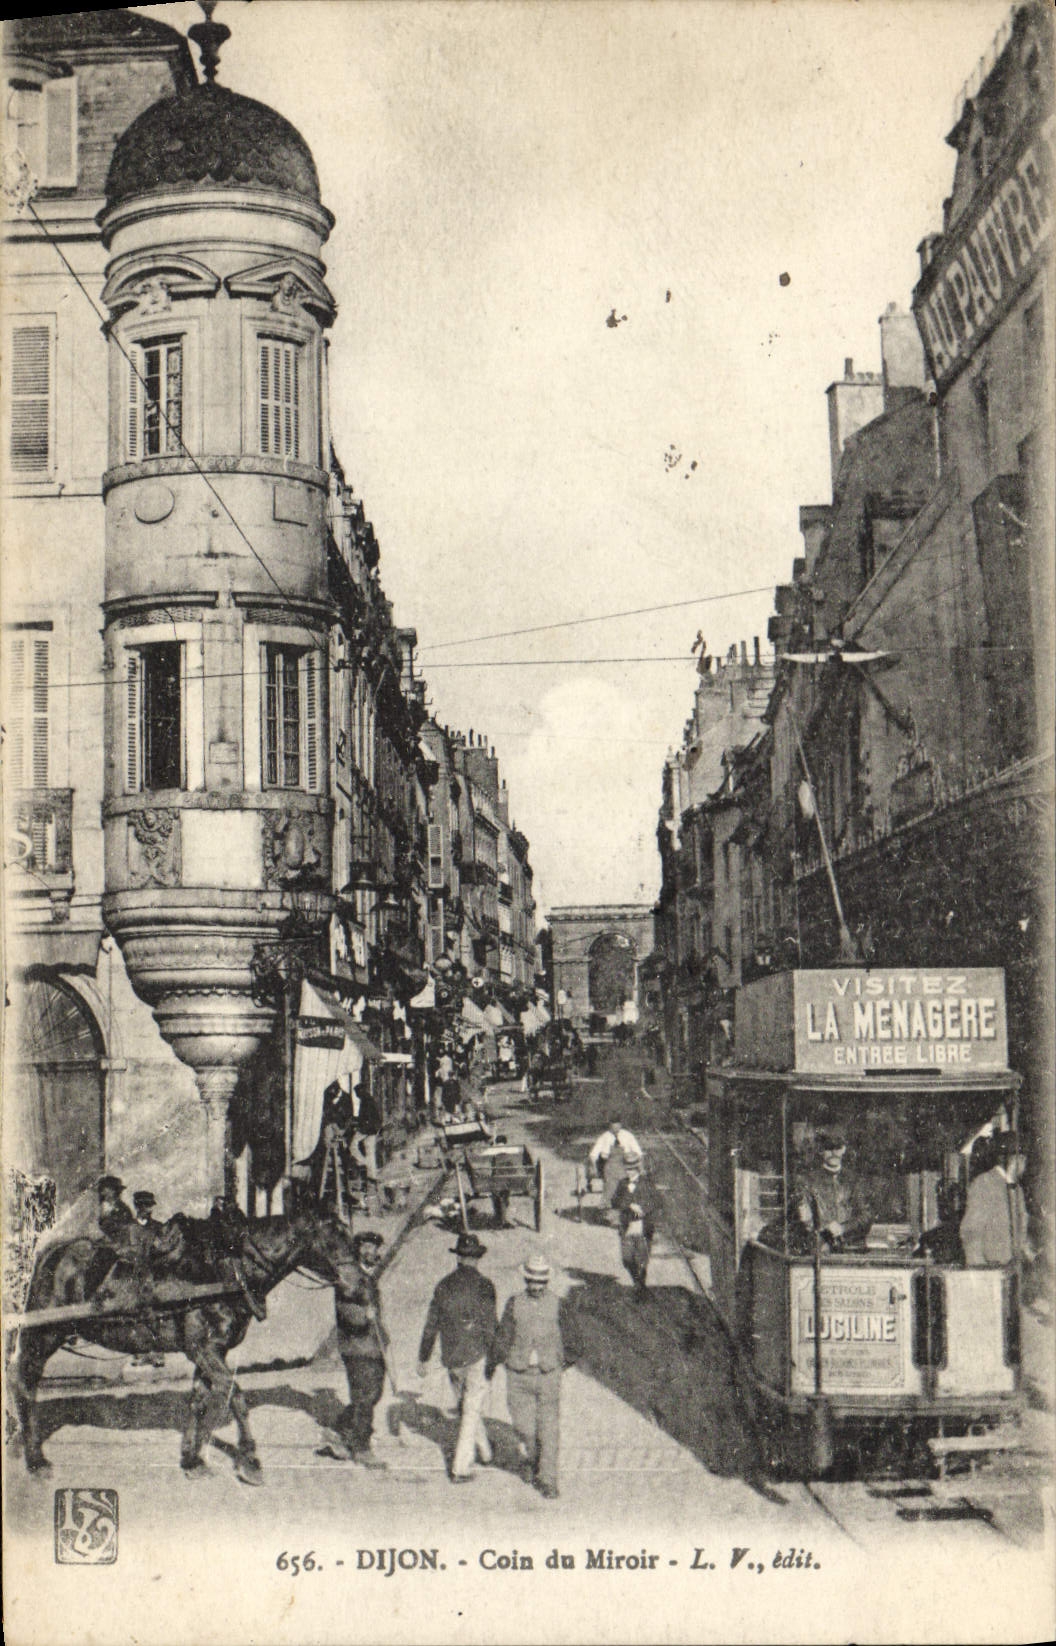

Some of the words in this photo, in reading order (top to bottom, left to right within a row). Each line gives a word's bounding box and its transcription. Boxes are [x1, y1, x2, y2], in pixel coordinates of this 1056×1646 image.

[923, 281, 960, 380] AU
[946, 149, 1051, 339] PAUVRE
[832, 976, 968, 996] VISITEZ
[806, 1002, 841, 1041] LA
[853, 997, 996, 1040] MÉNAGÈRE
[916, 1044, 972, 1063] LIBRE
[805, 1315, 897, 1342] LUCILINE
